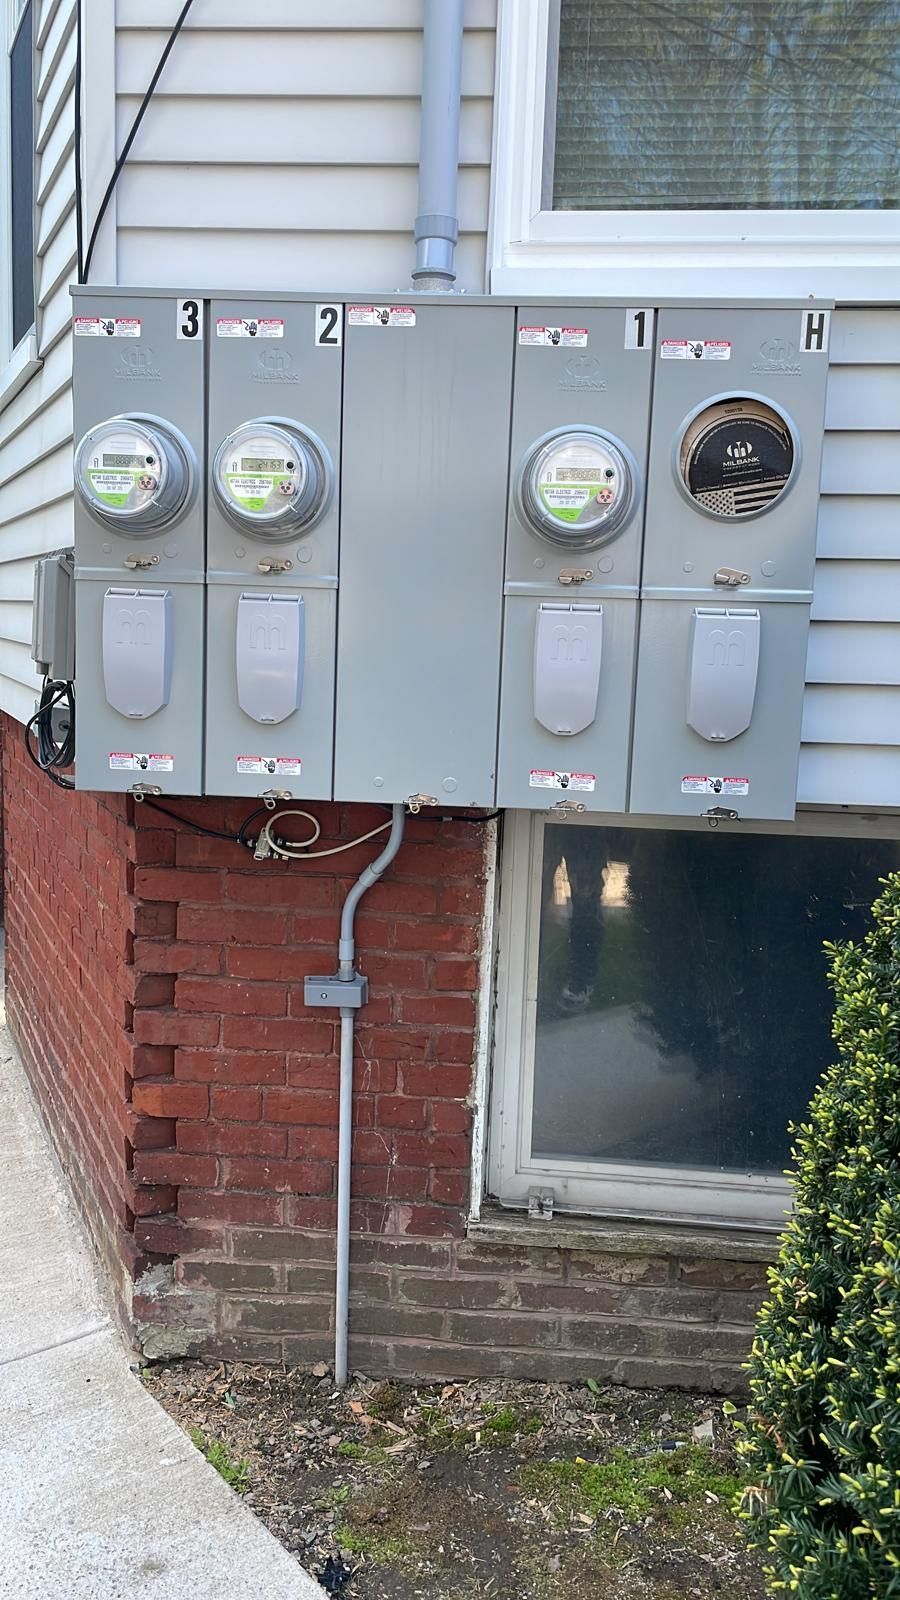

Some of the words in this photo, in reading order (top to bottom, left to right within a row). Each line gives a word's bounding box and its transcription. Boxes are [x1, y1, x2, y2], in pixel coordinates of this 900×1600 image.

[182, 301, 199, 338] 3
[319, 307, 338, 344] 2
[634, 311, 645, 347] 1
[805, 313, 824, 350] H
[722, 456, 760, 467] MILBANK
